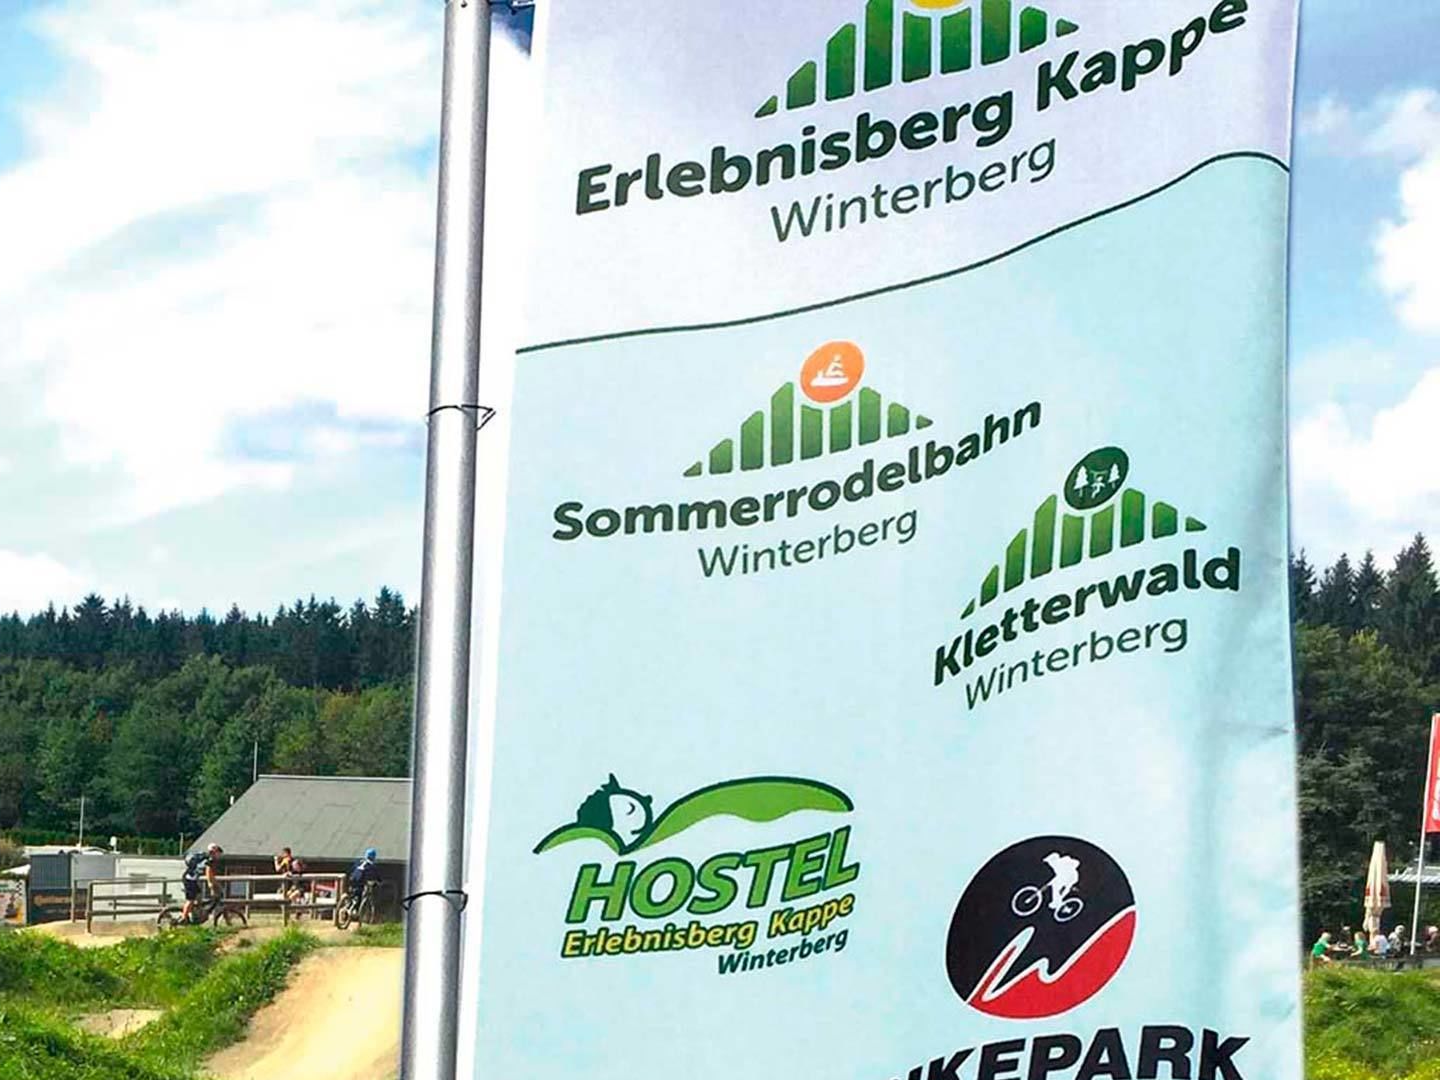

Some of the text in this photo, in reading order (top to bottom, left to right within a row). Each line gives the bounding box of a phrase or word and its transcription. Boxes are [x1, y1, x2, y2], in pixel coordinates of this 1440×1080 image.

[574, 0, 1248, 215] Erlebnisberg Kappe
[770, 135, 1056, 243] Winterberg
[552, 400, 1042, 541] Sommerrodelbahn
[697, 509, 918, 578] Winterberg
[934, 547, 1240, 686] Kletterwald
[965, 618, 1187, 710] Winterberg
[565, 826, 860, 924] HOSTEL
[561, 894, 855, 957] Erlebnisberg Kappe
[718, 929, 848, 974] Winterberg
